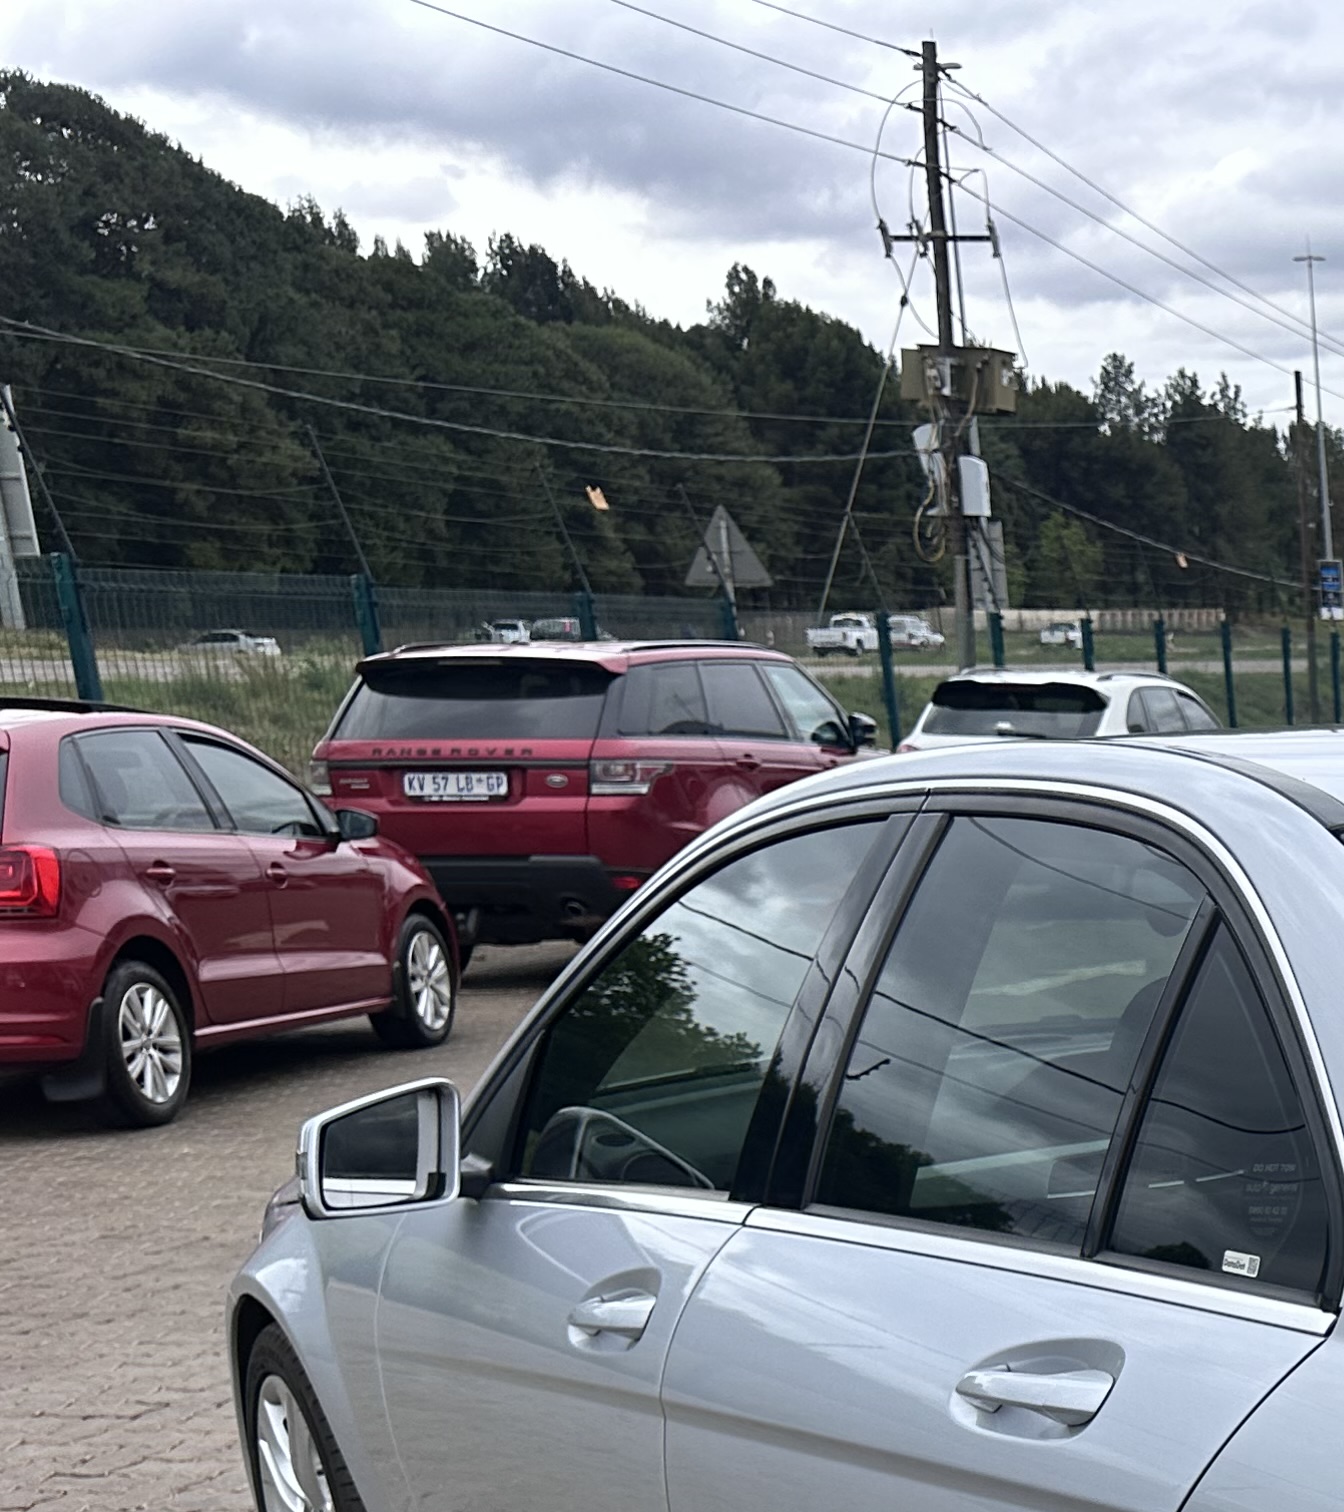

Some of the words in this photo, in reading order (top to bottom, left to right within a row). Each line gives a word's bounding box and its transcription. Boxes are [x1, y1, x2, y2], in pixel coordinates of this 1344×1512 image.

[372, 748, 441, 757] RANGE
[450, 748, 533, 757] ROVER
[408, 774, 426, 792] KV
[432, 774, 449, 792] 57
[456, 774, 473, 792] LB
[486, 775, 504, 792] GP
